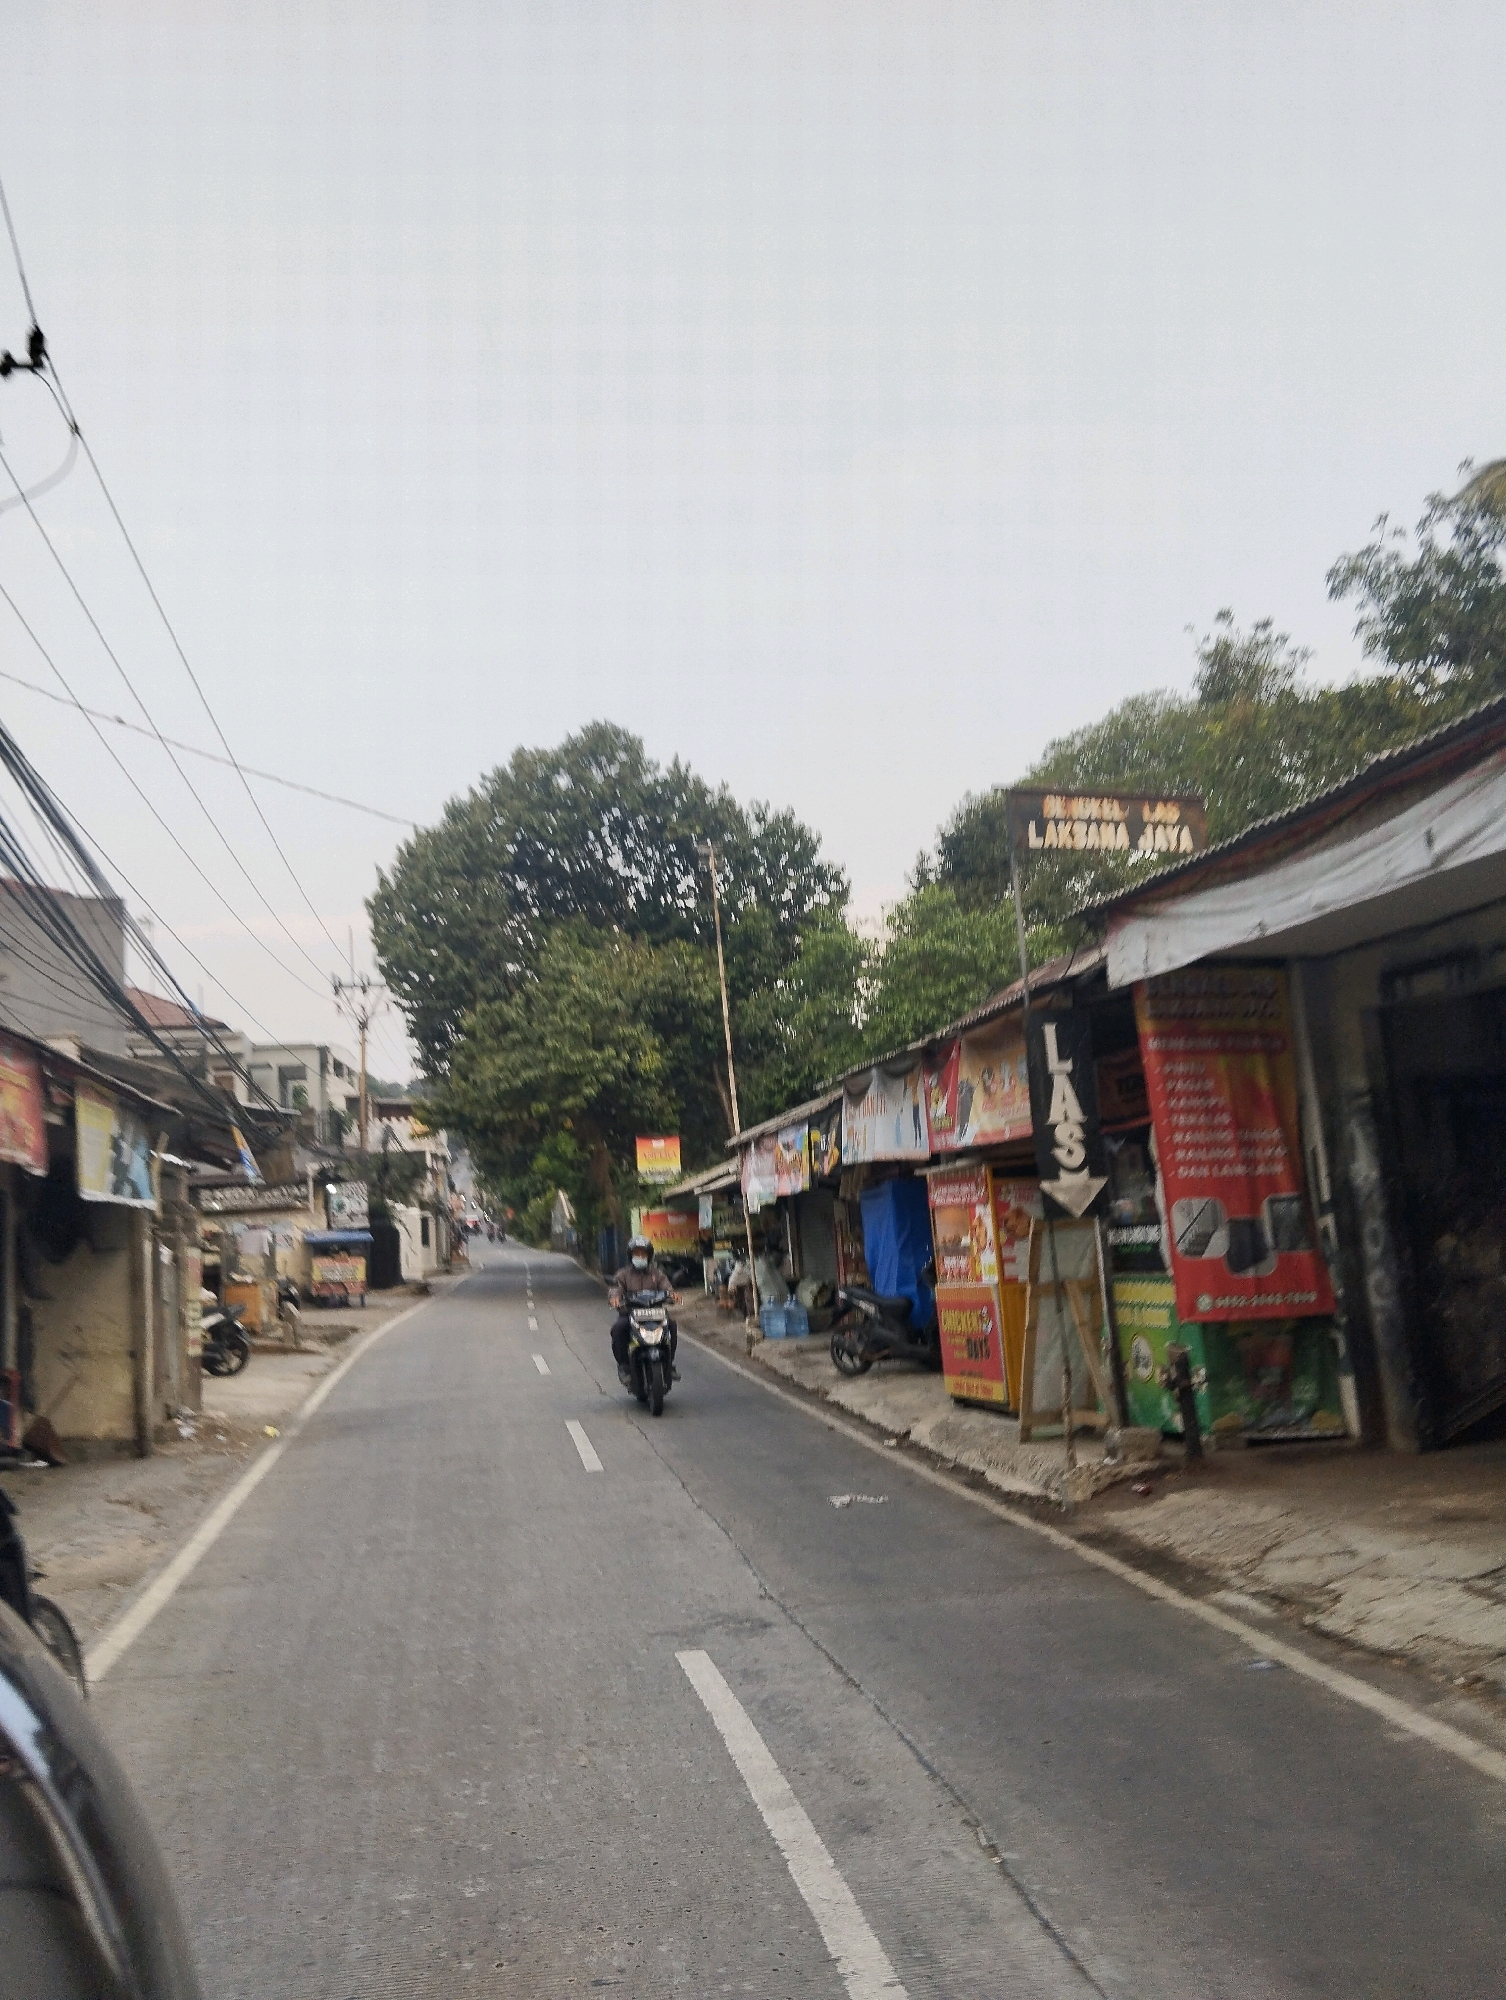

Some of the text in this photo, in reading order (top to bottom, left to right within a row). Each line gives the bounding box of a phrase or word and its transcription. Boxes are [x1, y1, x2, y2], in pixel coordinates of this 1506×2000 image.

[1142, 800, 1181, 825] LAS
[1028, 820, 1194, 854] LAKSANA JAYA
[1041, 1022, 1088, 1169] LAS
